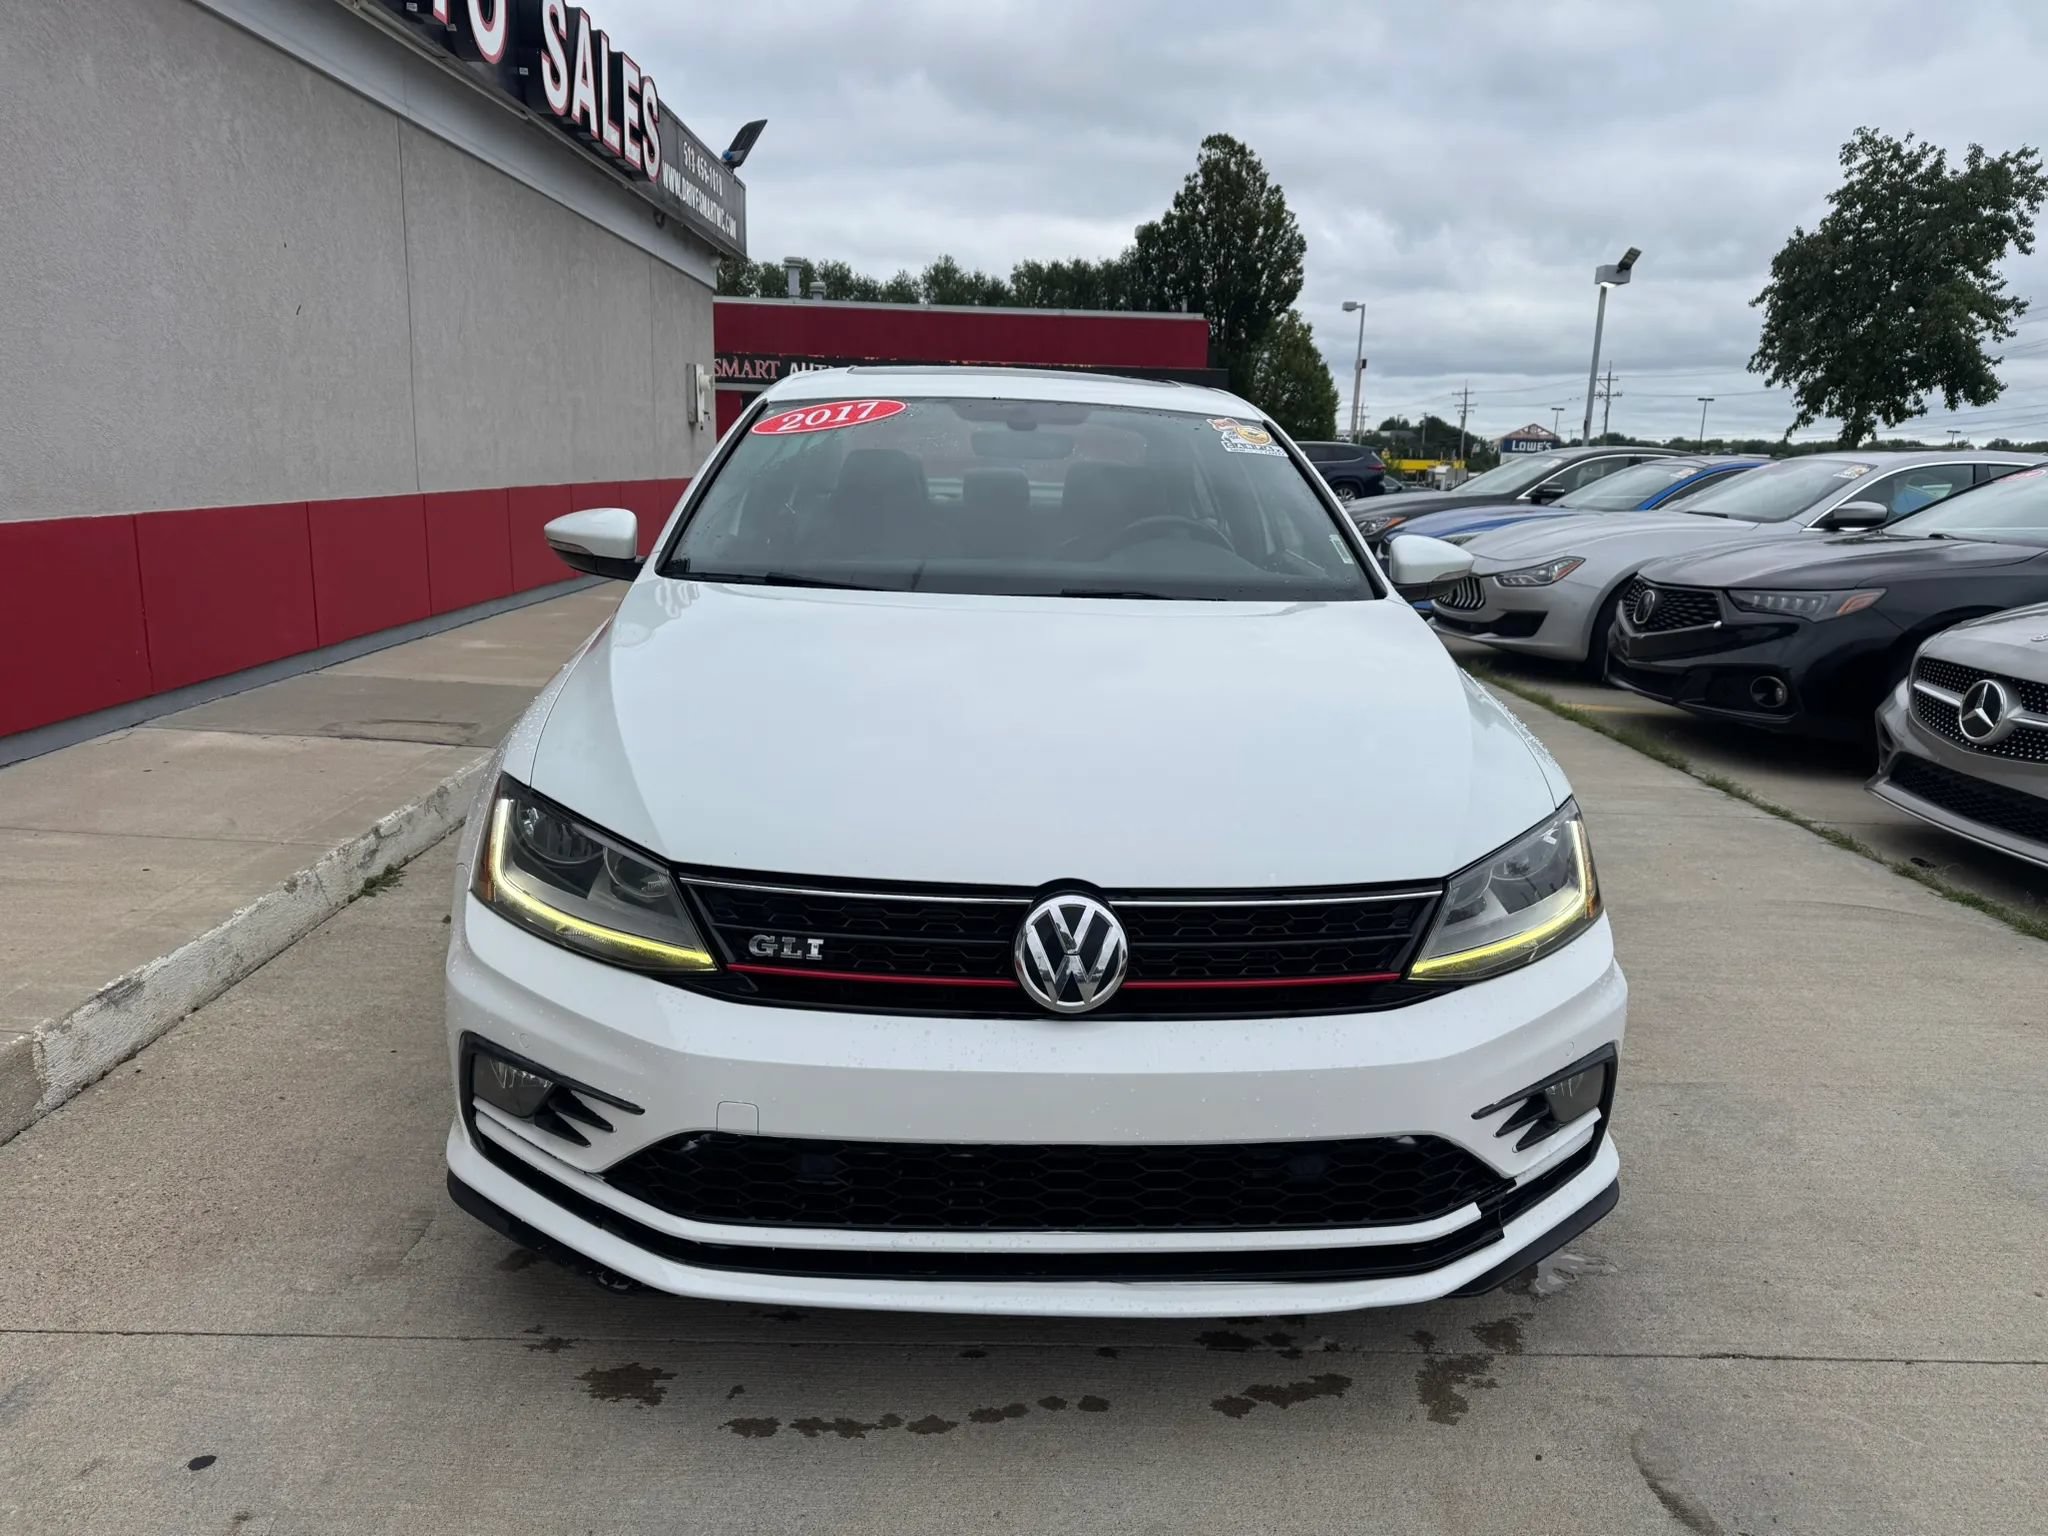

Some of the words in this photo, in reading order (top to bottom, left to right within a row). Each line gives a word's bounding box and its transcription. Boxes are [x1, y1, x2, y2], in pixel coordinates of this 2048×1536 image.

[541, 0, 661, 183] SALES
[714, 357, 780, 379] SMART
[776, 402, 880, 432] 2017
[748, 934, 823, 961] GLI
[1021, 898, 1123, 1009] VW
